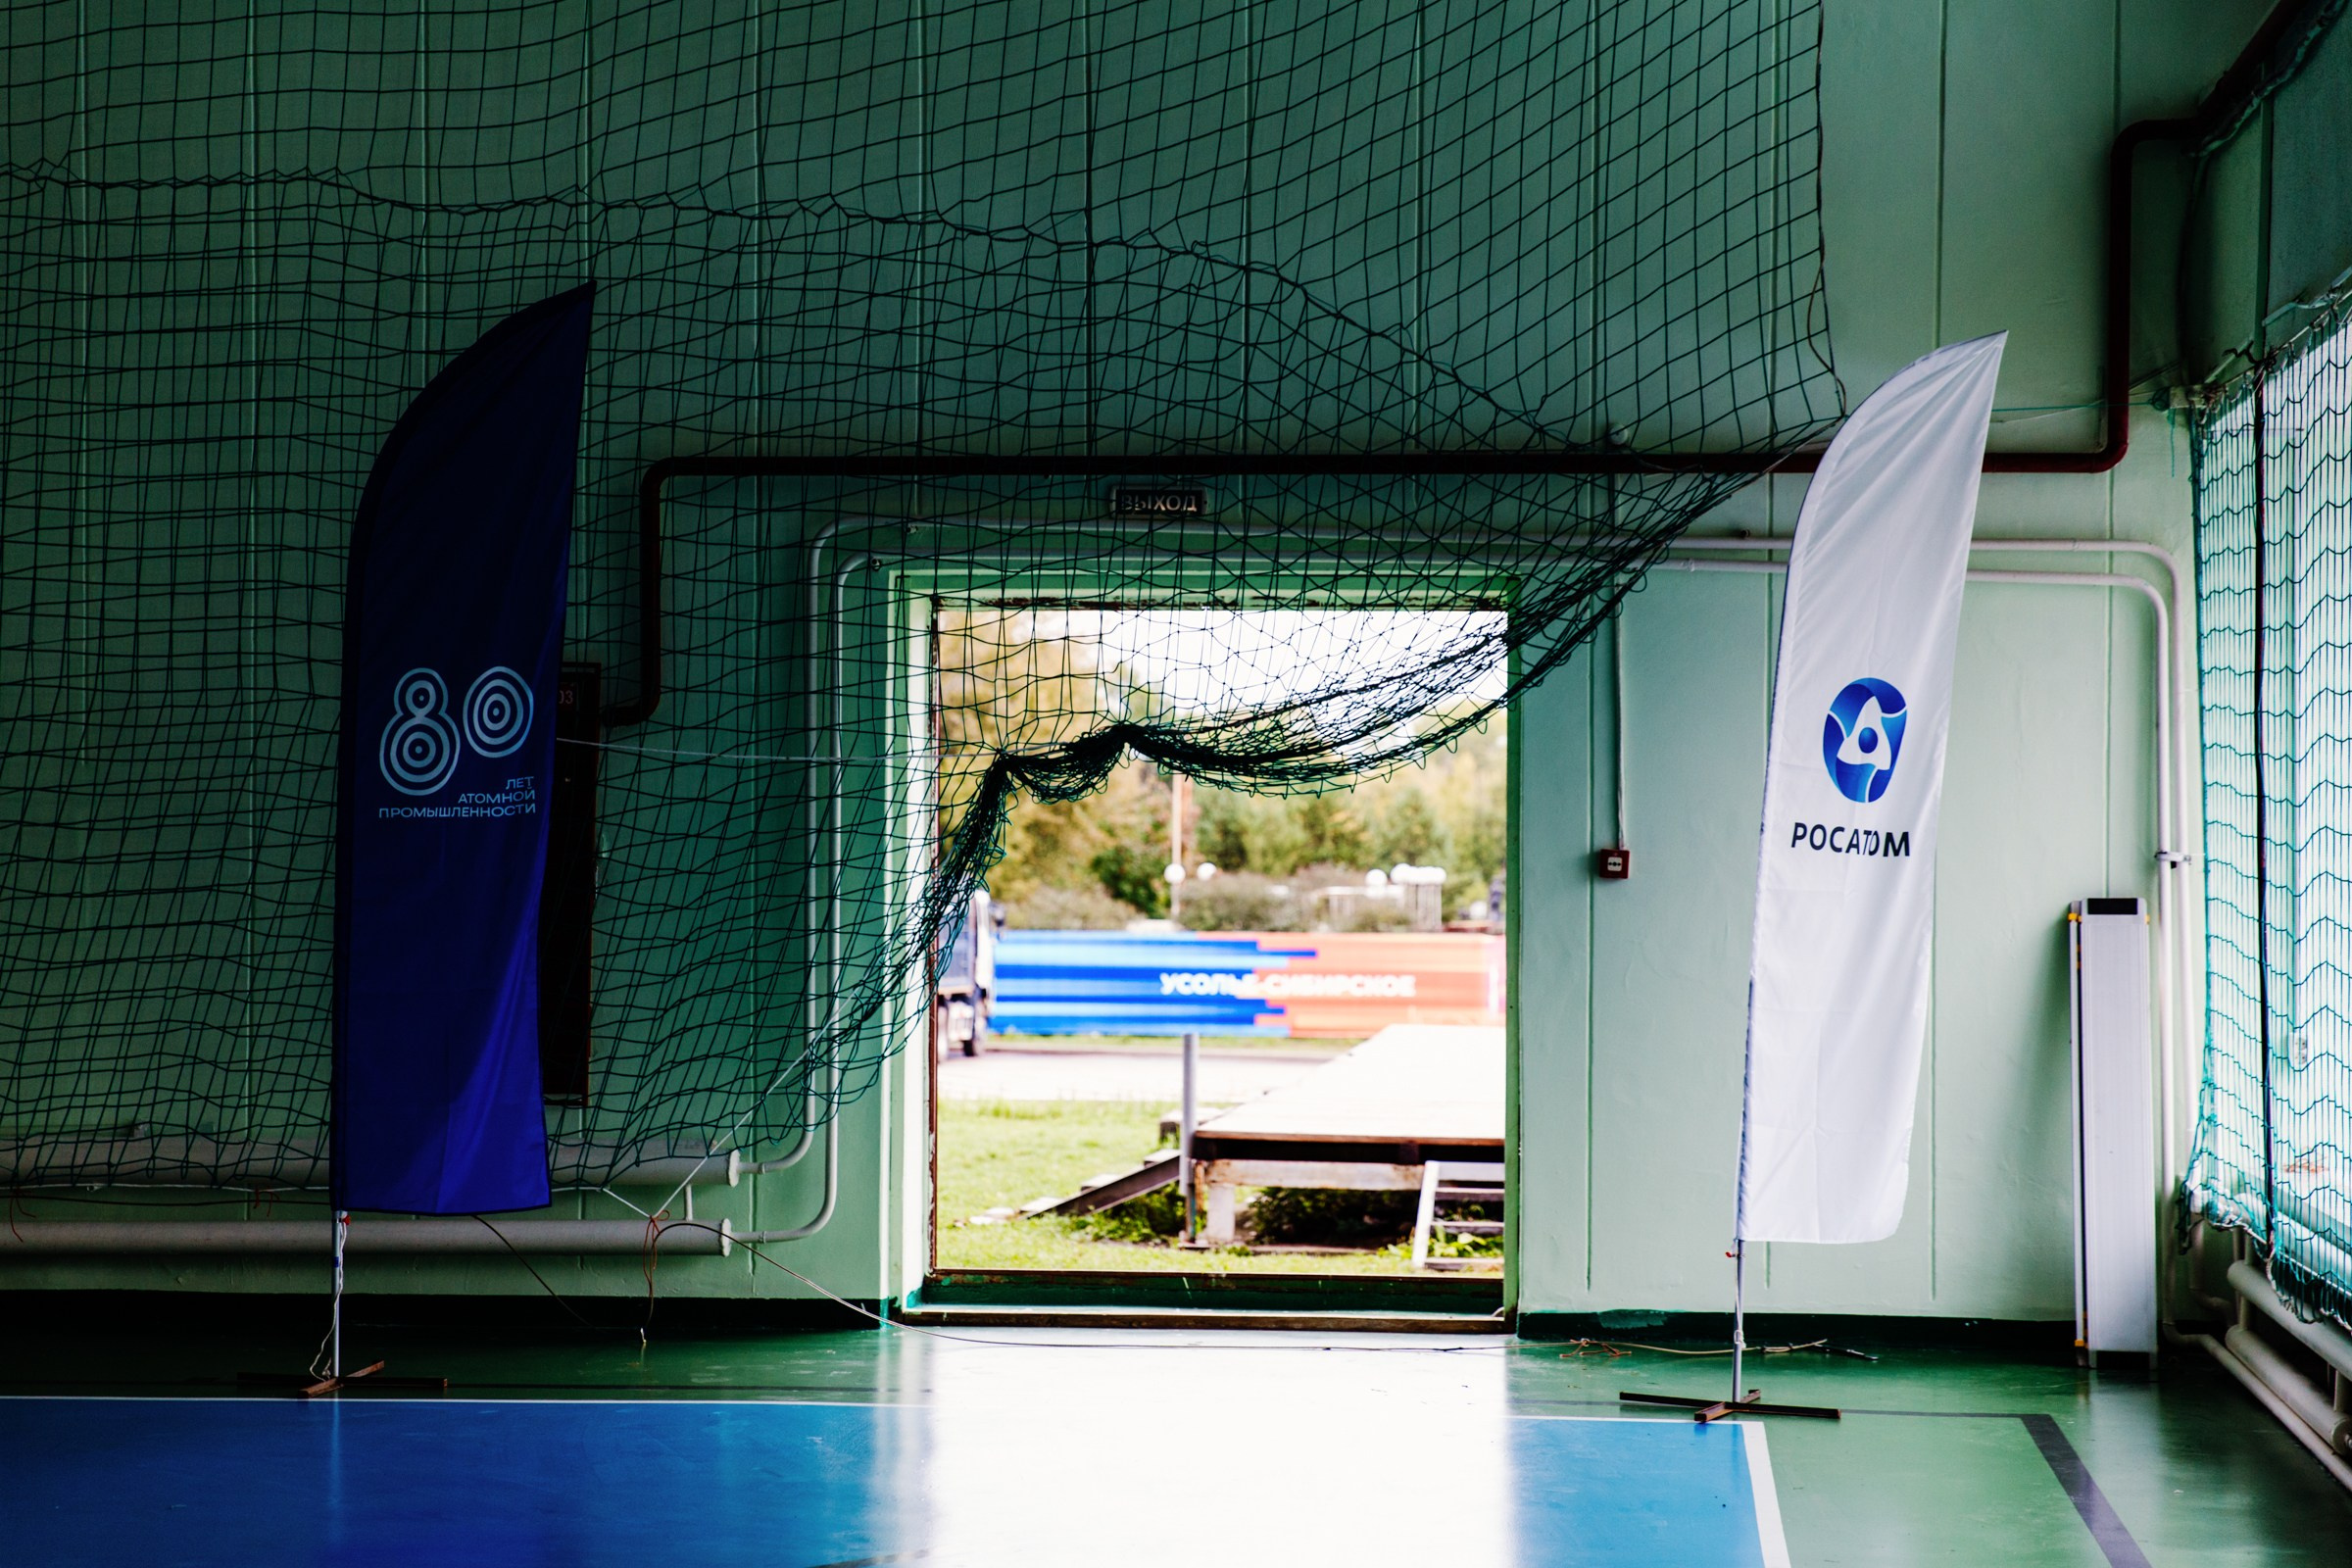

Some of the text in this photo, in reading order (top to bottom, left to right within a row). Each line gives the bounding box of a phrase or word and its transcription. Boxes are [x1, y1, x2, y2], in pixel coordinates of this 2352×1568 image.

[1121, 494, 1198, 513] ВЫХОД
[378, 665, 535, 796] 80
[505, 776, 535, 790] ЛЕТ
[458, 787, 536, 804] АТОМНОЙ
[378, 803, 536, 819] ПРОМЫШЛЕННОСТИ
[1790, 821, 1911, 858] РОСАТОМ
